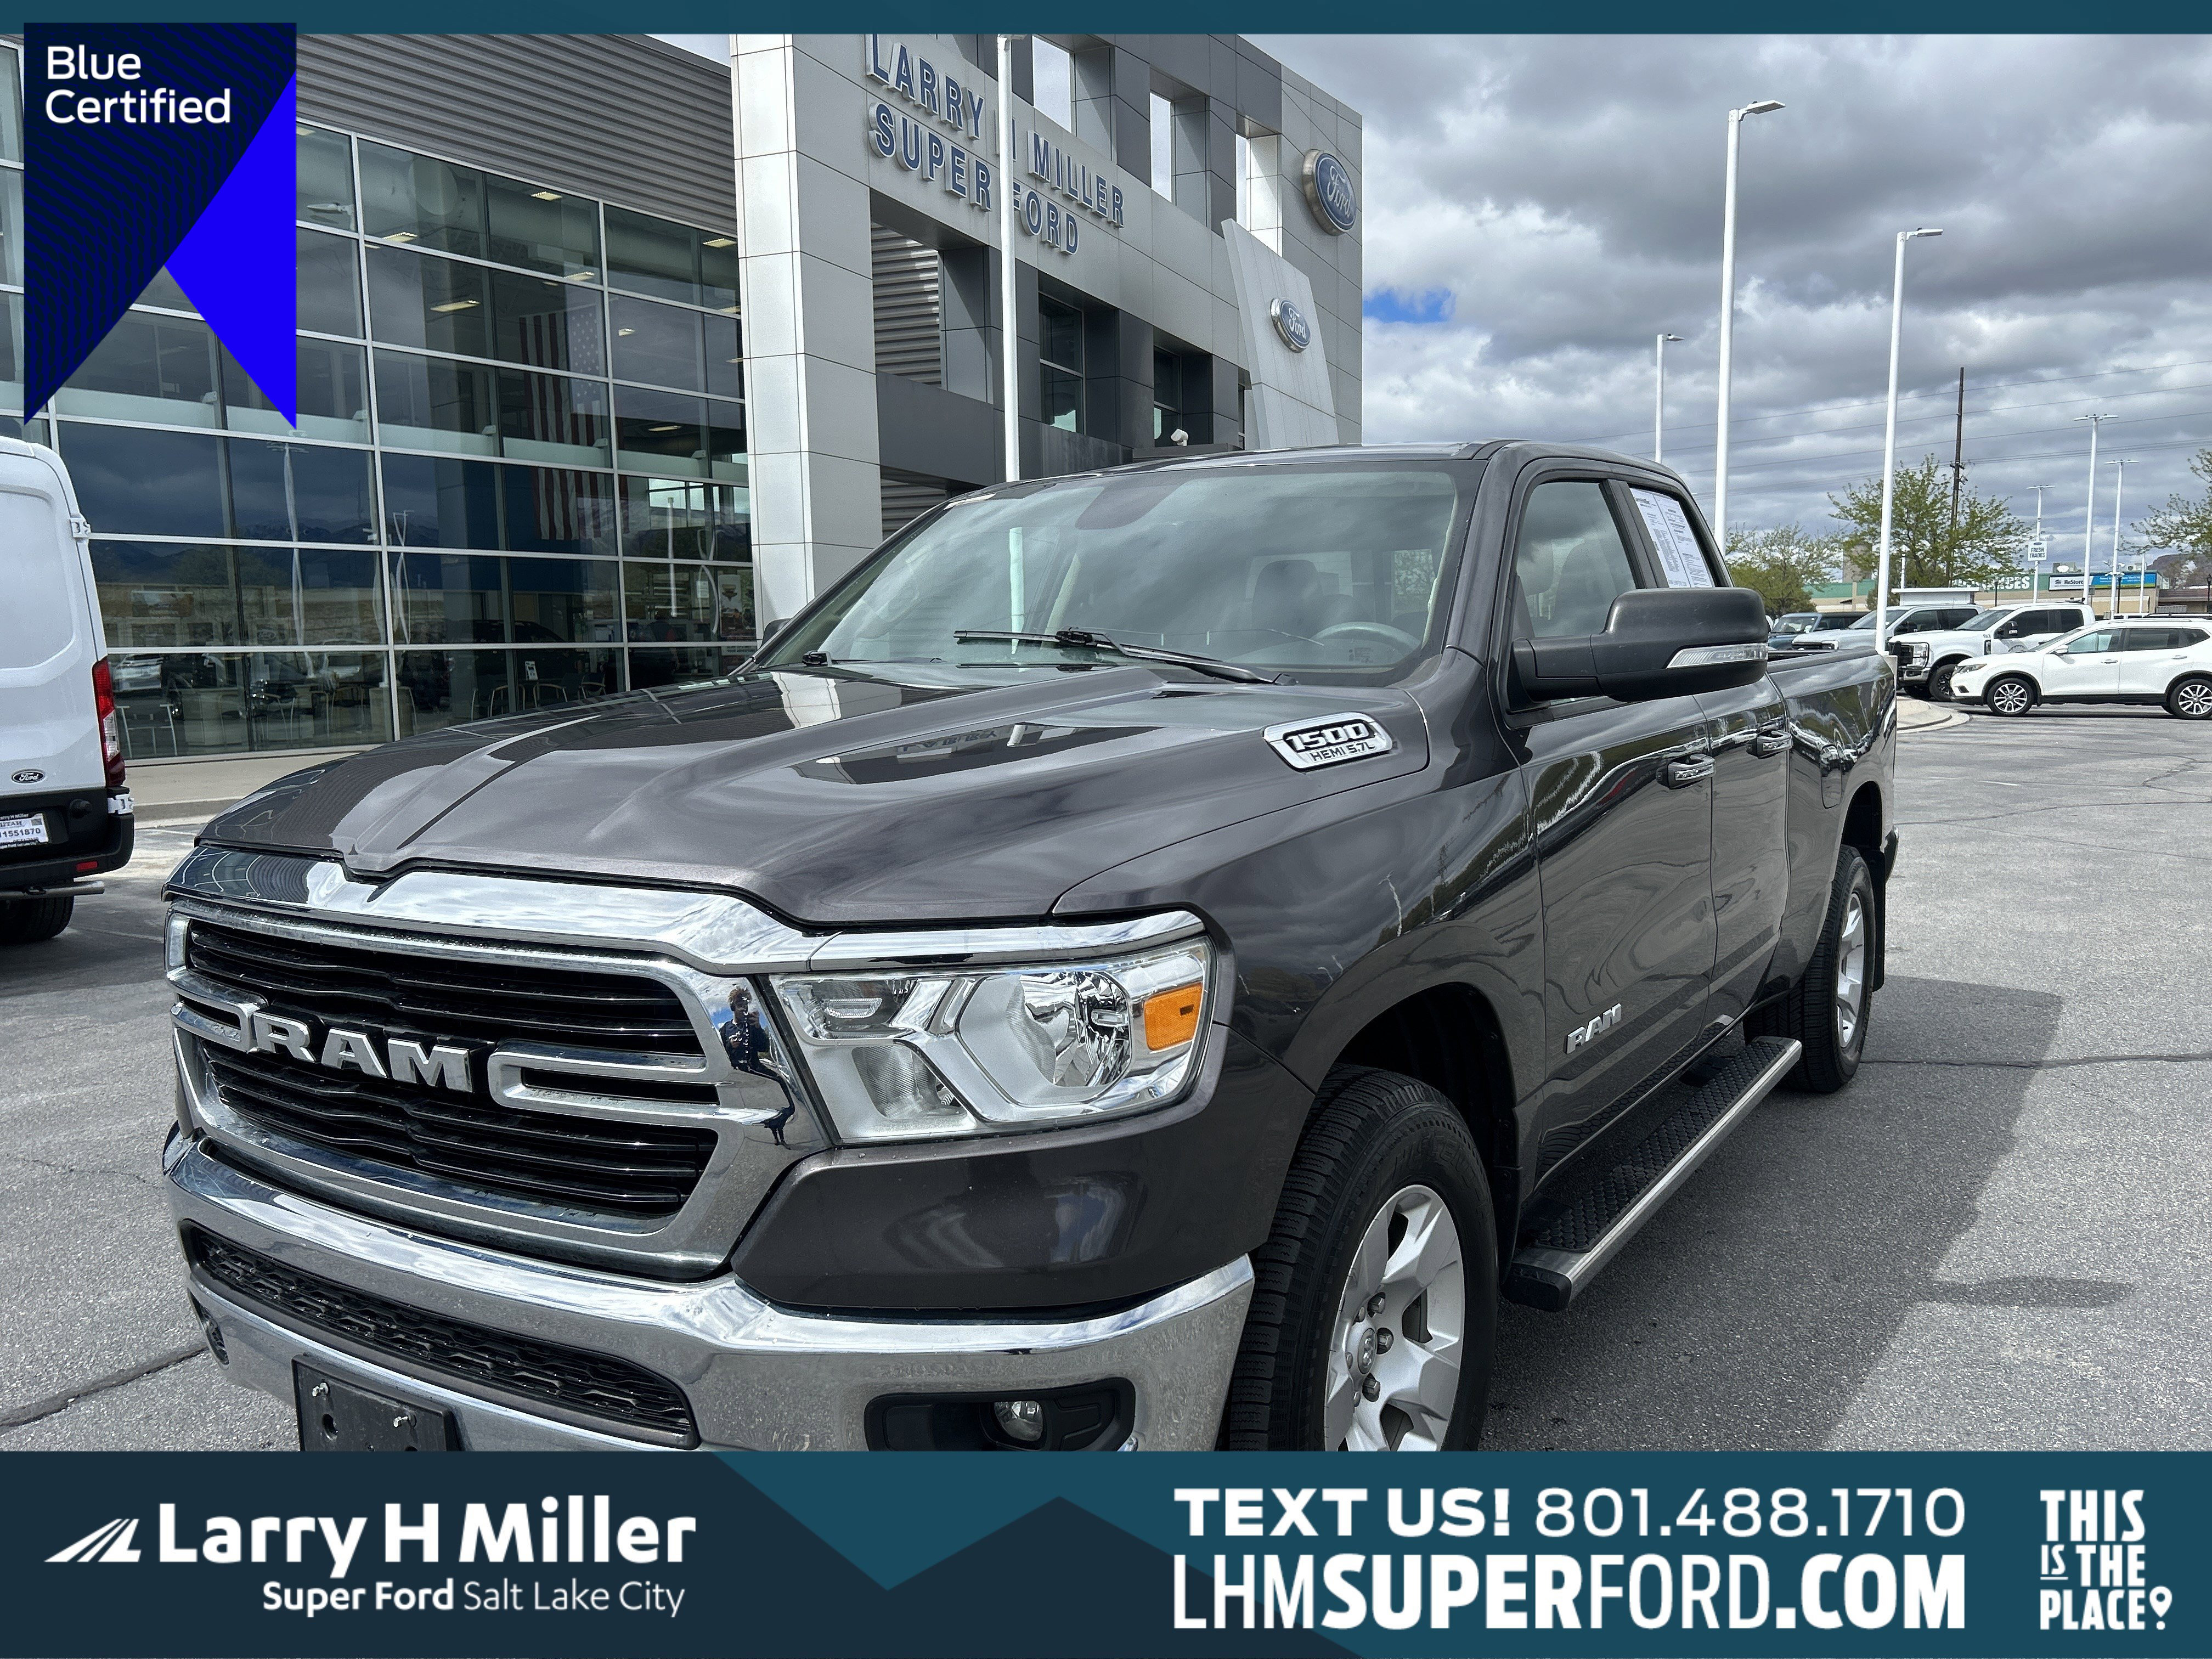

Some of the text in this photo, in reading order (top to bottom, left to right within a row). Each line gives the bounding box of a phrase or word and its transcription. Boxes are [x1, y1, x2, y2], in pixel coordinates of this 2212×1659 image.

[866, 34, 985, 140] LARRY
[1028, 130, 1124, 228] MILLER
[868, 103, 992, 212] SUPER
[1286, 723, 1369, 751] 1500
[1310, 741, 1375, 761] HEMI 5.7L
[19, 772, 38, 781] Ford
[253, 1010, 473, 1093] RAM
[1566, 1003, 1622, 1054] RAM
